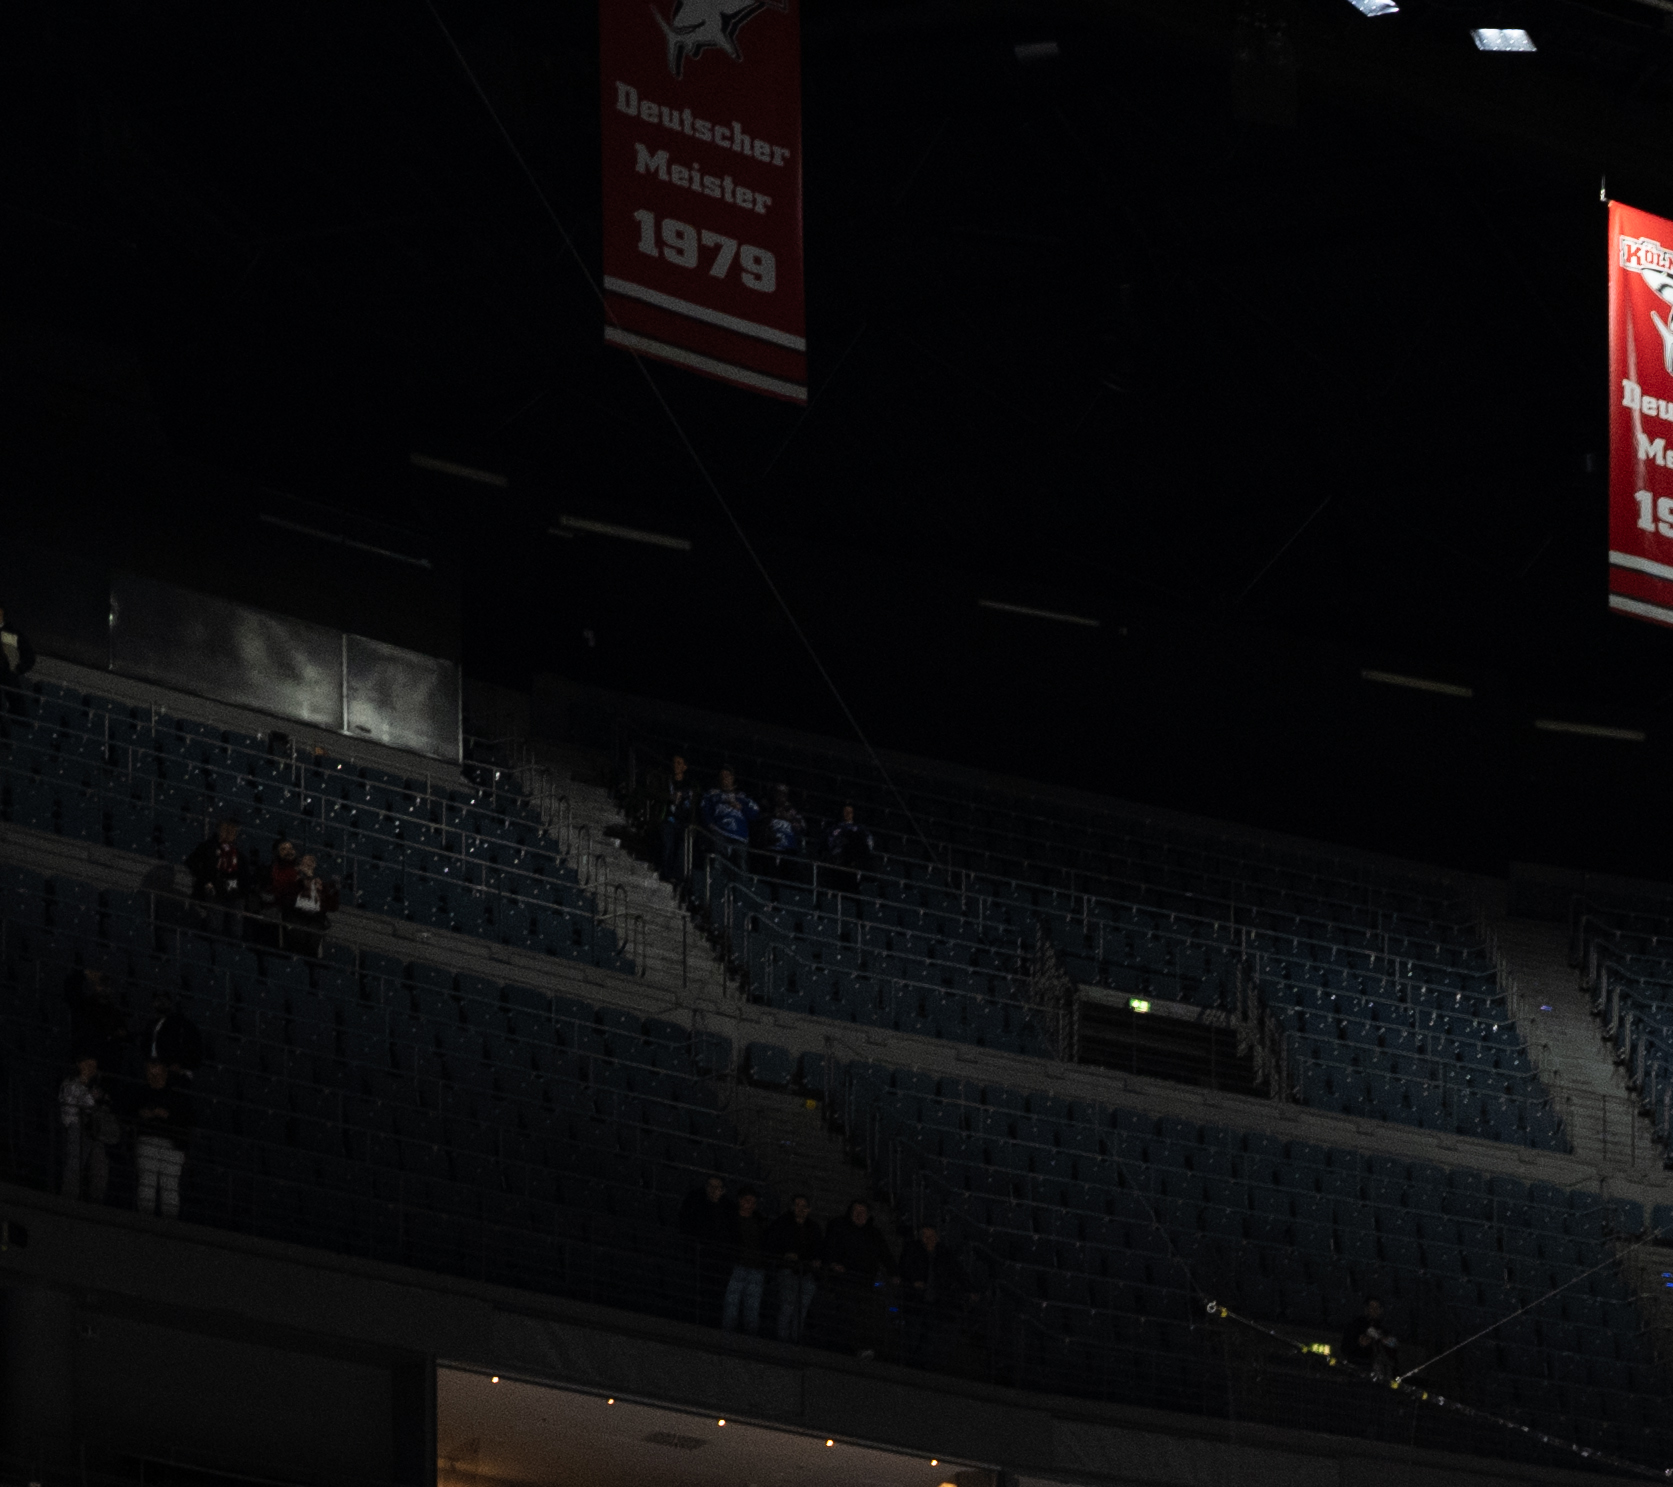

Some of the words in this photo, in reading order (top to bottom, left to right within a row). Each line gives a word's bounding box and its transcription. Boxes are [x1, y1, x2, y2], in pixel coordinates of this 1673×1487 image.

[615, 80, 790, 167] Deutscher
[634, 142, 772, 215] Meister
[633, 209, 777, 293] 1979
